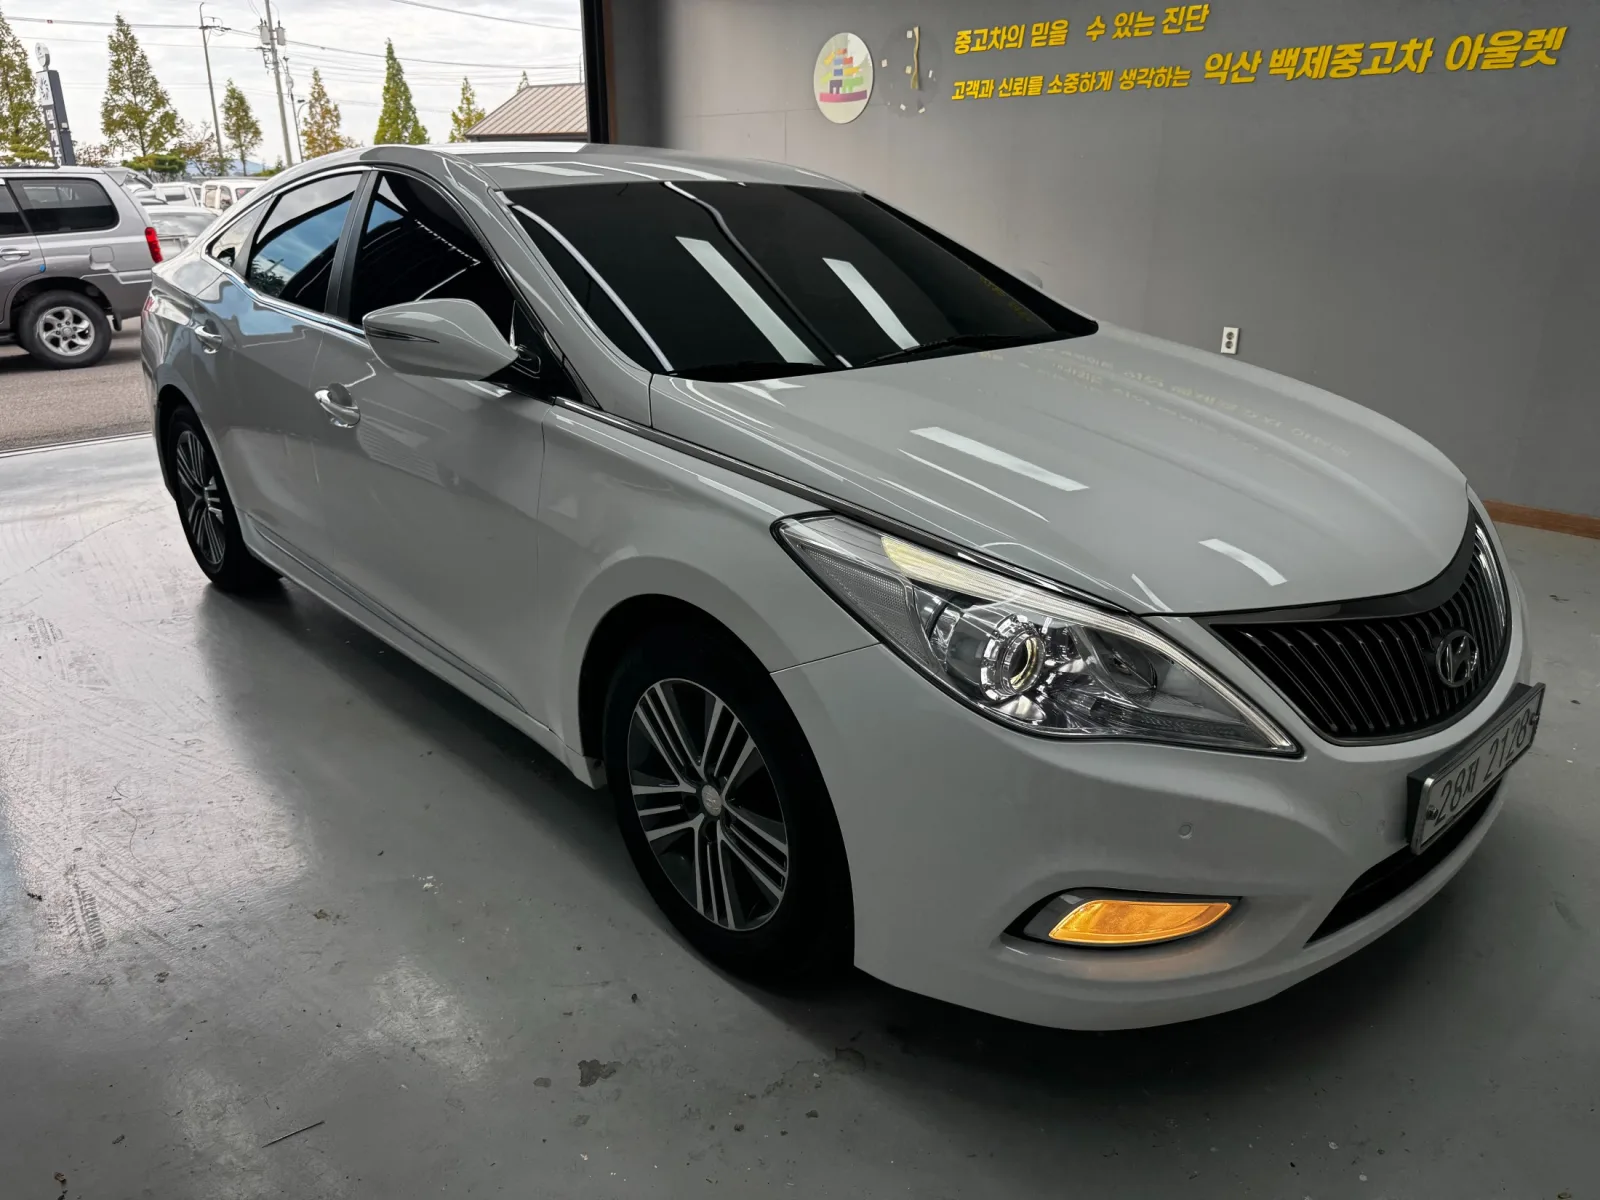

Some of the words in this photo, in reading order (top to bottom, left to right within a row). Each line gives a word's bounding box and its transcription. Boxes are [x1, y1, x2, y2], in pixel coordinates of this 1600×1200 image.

[951, 79, 995, 101] 고객과
[997, 75, 1044, 98] 신뢰를
[1047, 70, 1114, 95] 소중하게
[1118, 65, 1191, 91] 생각하는
[1204, 49, 1263, 85] 익산
[1268, 37, 1434, 81] 백제중고차
[1445, 26, 1568, 71] 아울렛
[954, 24, 1026, 55] 중고차의
[1030, 18, 1069, 48] 믿을
[1085, 15, 1106, 42] 수
[1112, 11, 1156, 40] 있는
[1161, 3, 1210, 35] 진단
[1483, 708, 1531, 783] 2128
